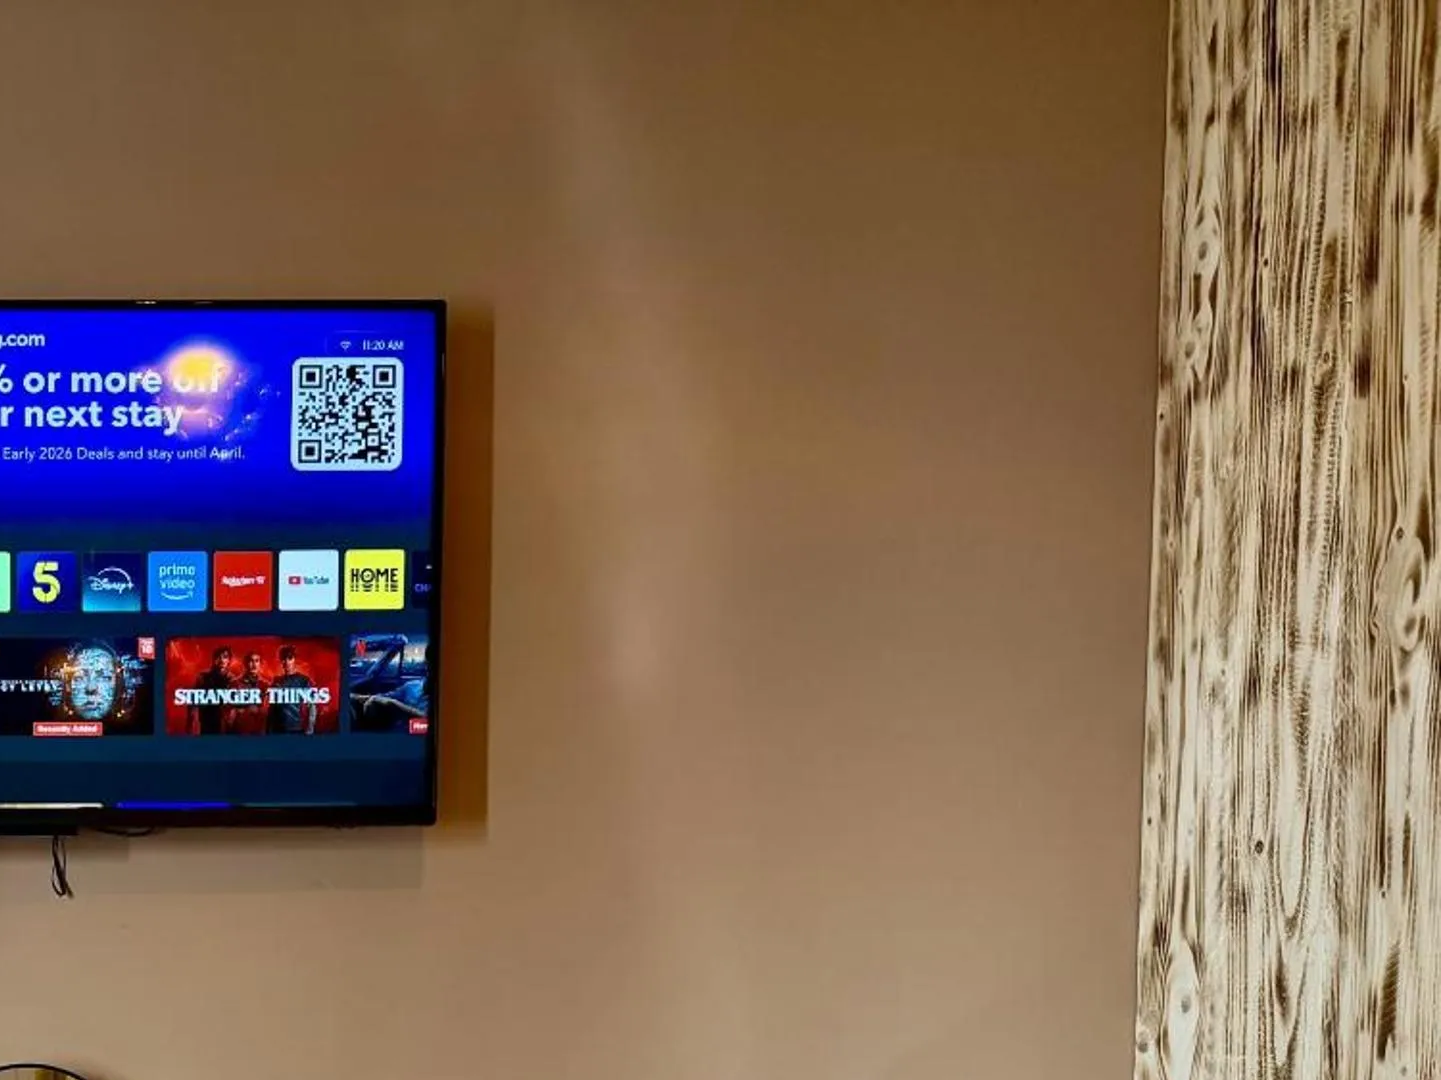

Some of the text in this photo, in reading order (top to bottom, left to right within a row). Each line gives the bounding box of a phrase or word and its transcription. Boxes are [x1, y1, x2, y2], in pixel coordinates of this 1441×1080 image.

[23, 371, 62, 394] or
[71, 371, 161, 394] more
[24, 401, 103, 428] next
[112, 401, 185, 436] stay
[2, 446, 36, 464] Early
[39, 447, 72, 460] 2026
[76, 446, 115, 460] Deals
[117, 446, 144, 460] and
[147, 446, 174, 463] stay
[176, 445, 207, 460] until
[209, 445, 246, 463] April.
[159, 564, 196, 578] prime
[350, 568, 399, 592] HOME
[32, 561, 61, 604] 5
[160, 577, 196, 590] video
[174, 687, 331, 705] STRANGER THINGS
